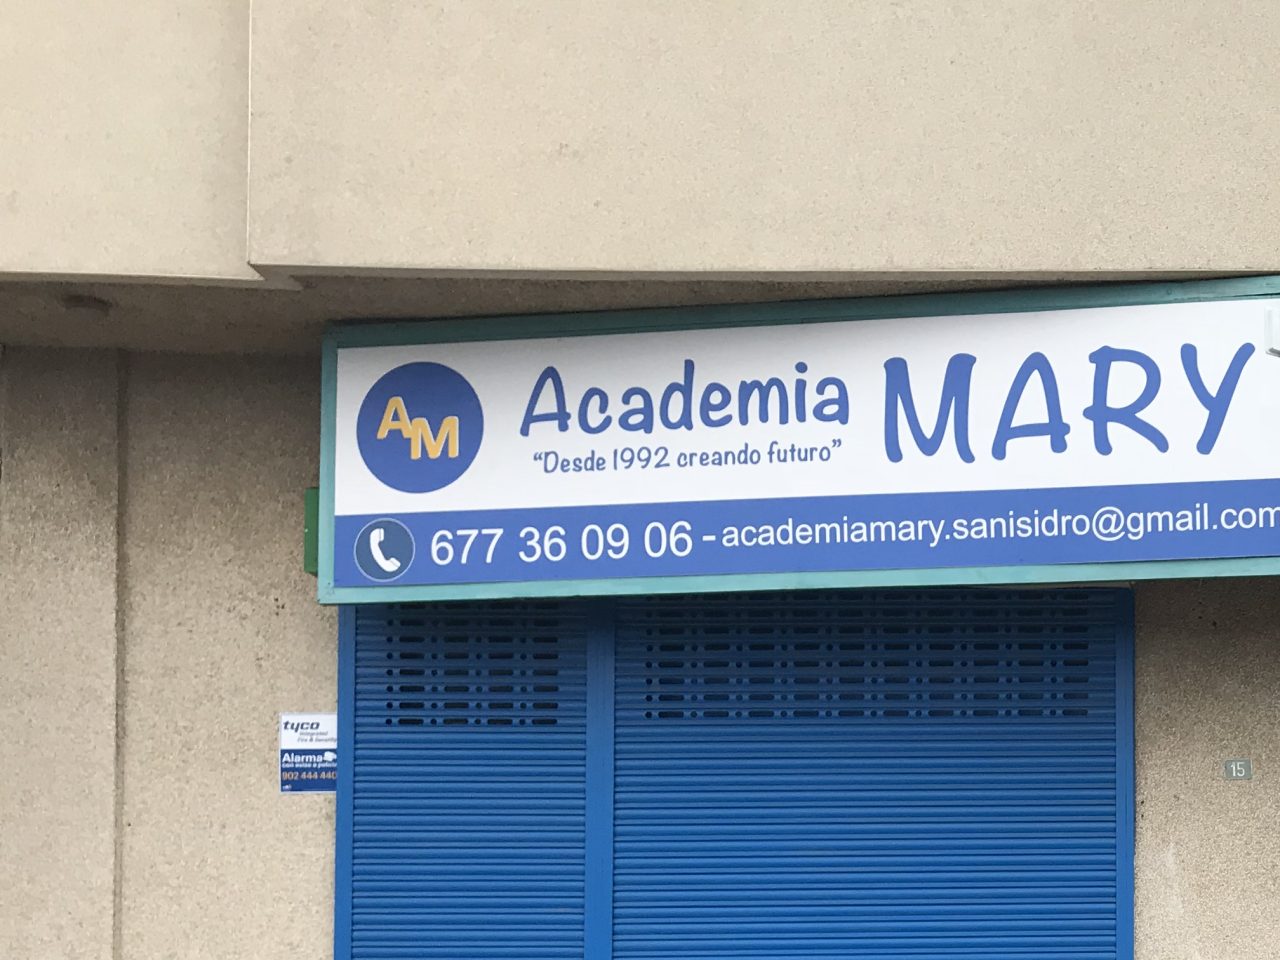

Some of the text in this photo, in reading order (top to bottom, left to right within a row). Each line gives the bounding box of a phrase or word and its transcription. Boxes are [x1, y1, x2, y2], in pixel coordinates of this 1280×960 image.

[519, 342, 1256, 464] Academia MARY
[377, 396, 459, 460] AM
[613, 446, 670, 470] 1992
[676, 443, 761, 467] creando
[430, 528, 504, 566] 677
[518, 525, 567, 562] 36
[581, 523, 630, 561] 09
[644, 520, 693, 558] 06
[283, 721, 320, 733] tyco
[282, 753, 323, 762] Alarma
[1230, 761, 1245, 777] 15
